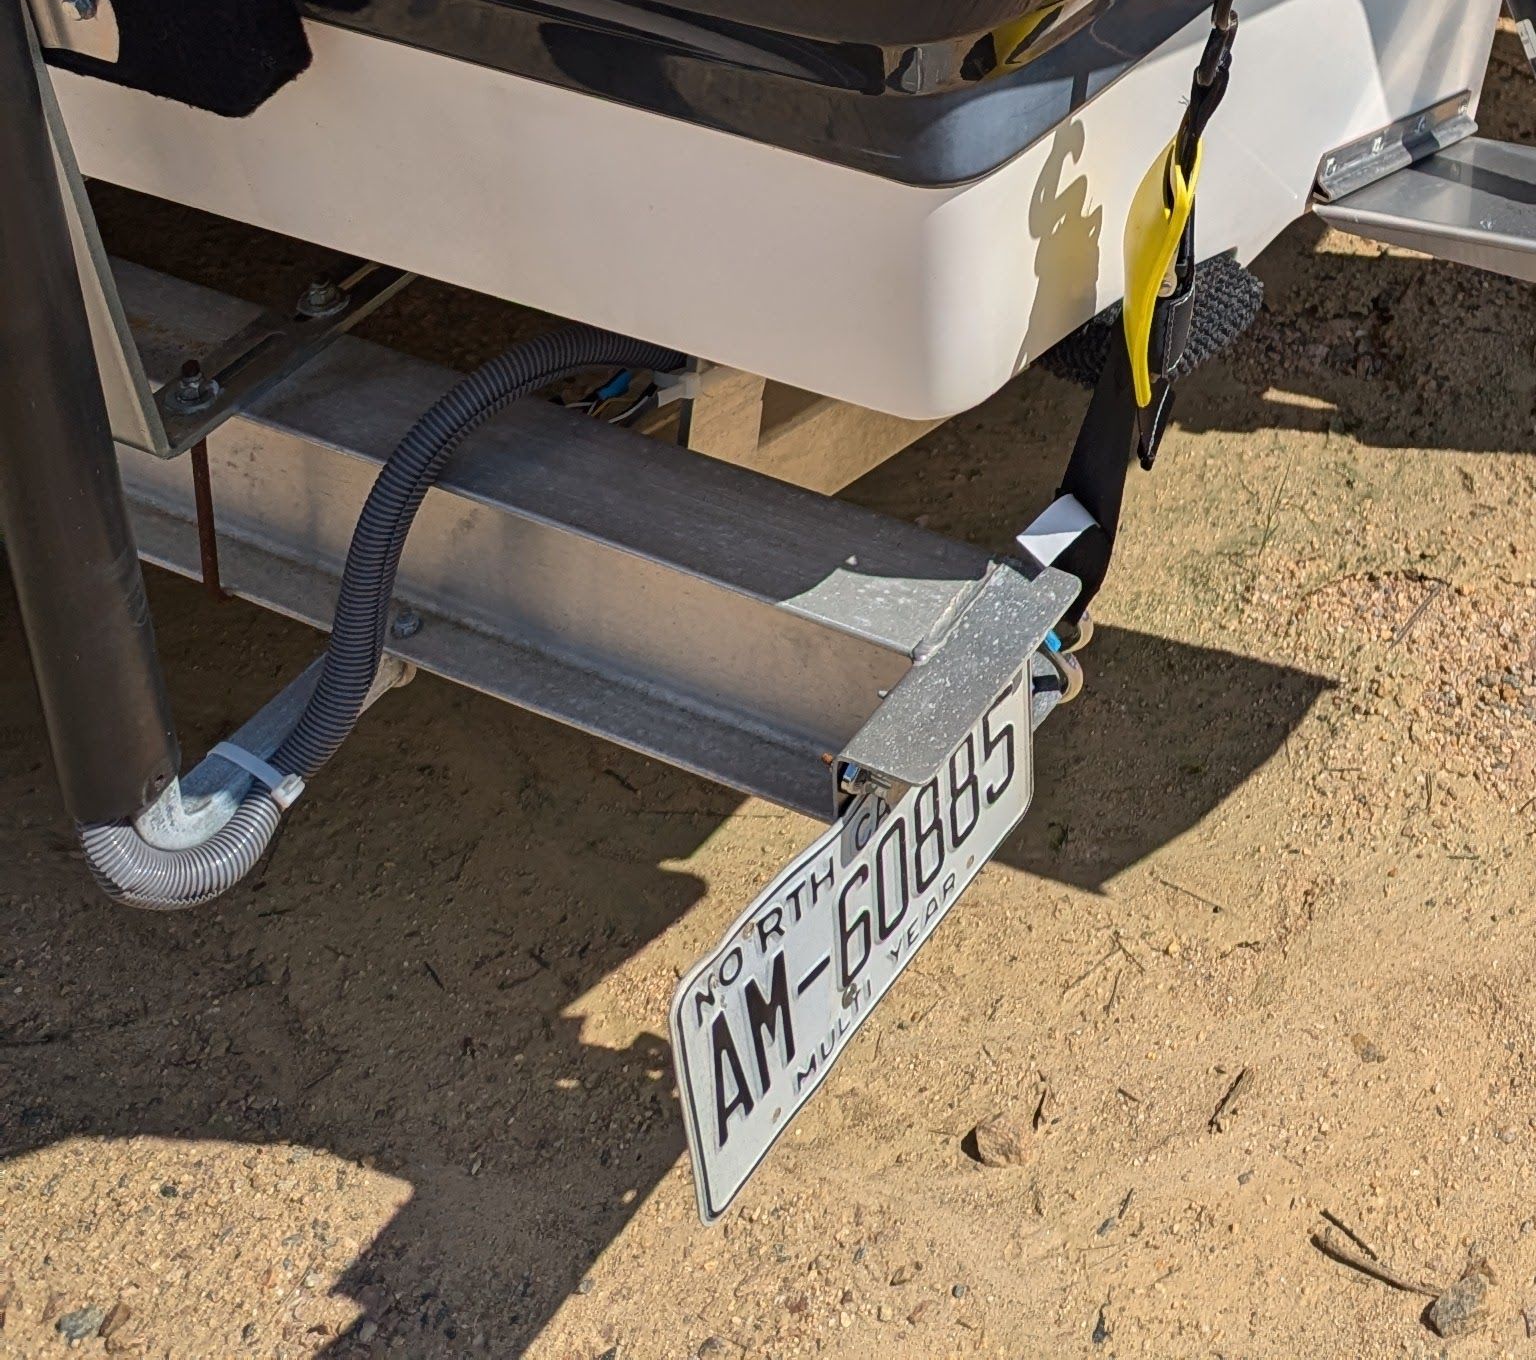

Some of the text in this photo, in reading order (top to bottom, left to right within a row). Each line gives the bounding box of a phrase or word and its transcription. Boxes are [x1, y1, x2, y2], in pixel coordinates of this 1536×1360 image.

[694, 855, 835, 1028] NORTH
[711, 682, 1015, 1149] AM-60885
[797, 871, 956, 1092] MULTI YEAR
